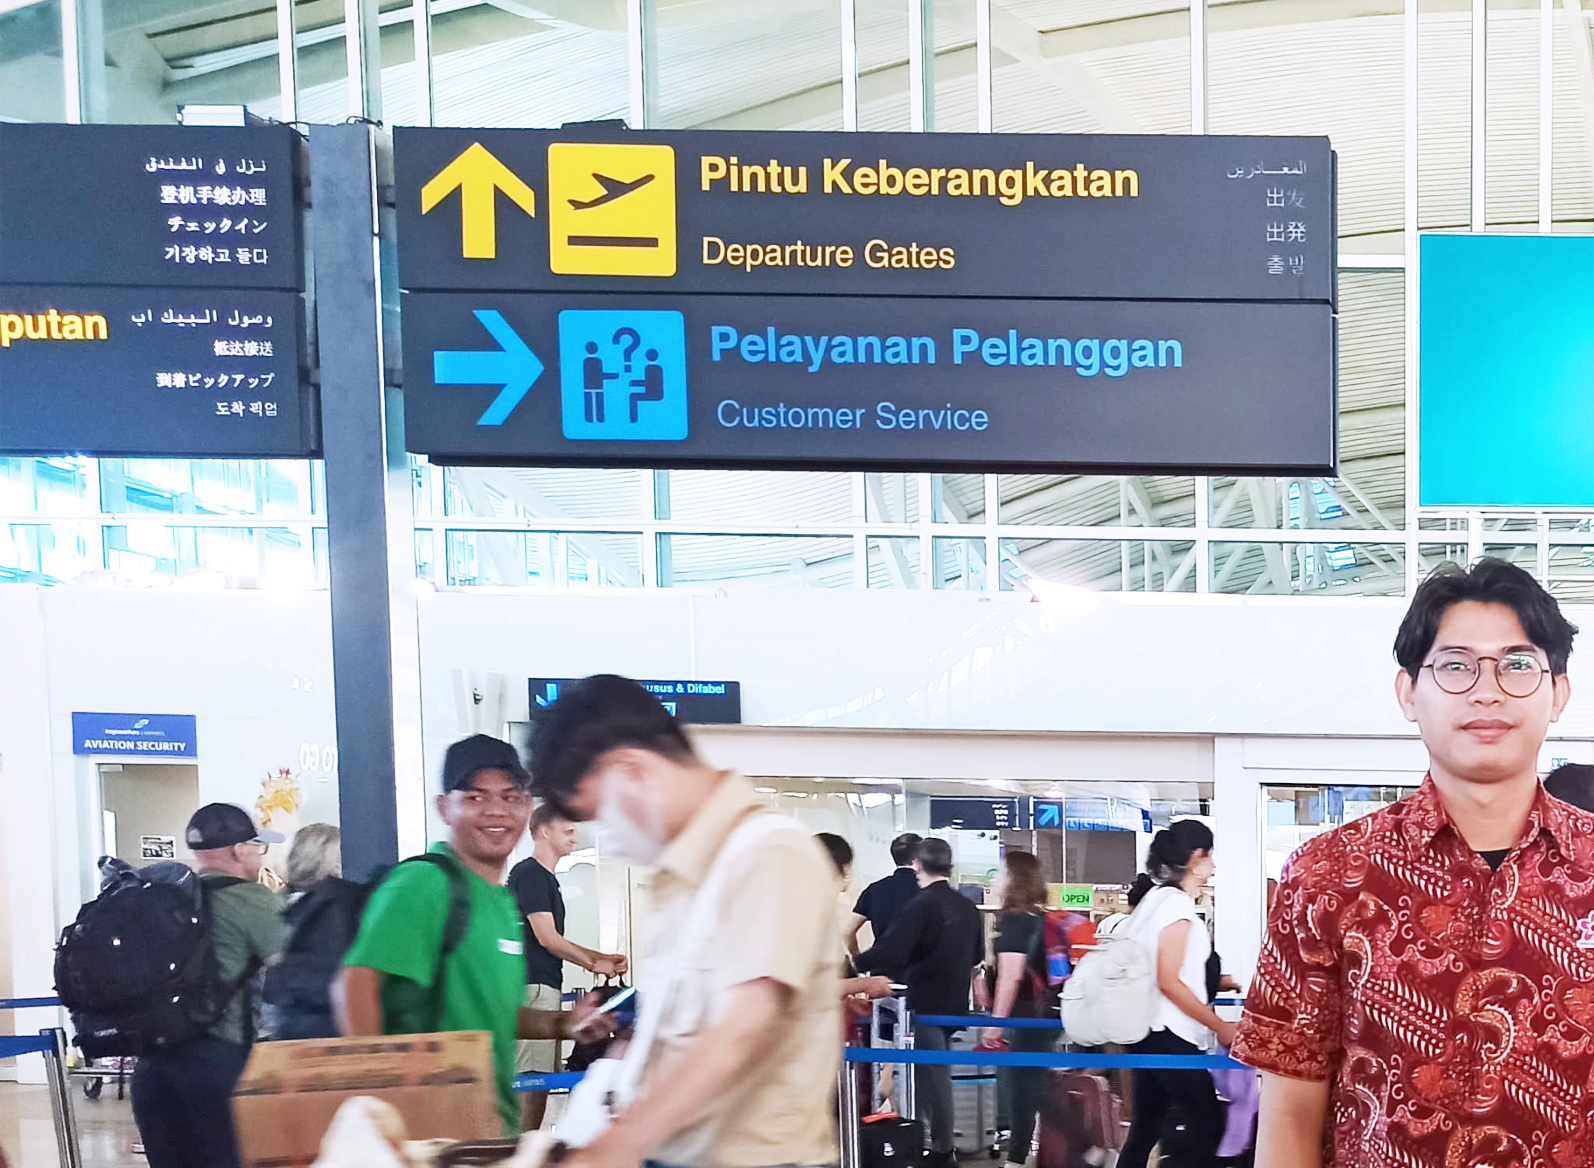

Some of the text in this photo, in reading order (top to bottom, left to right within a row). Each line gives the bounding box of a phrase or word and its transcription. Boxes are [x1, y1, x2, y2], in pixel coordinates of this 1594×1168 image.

[700, 156, 1140, 206] Pintu Keberangkatan
[160, 185, 267, 206] 登机手续办理
[168, 216, 268, 234] チェックイン
[1266, 221, 1307, 242] 出発
[165, 244, 268, 265] 기장하고 들다
[702, 236, 955, 271] Departure Gates
[0, 308, 108, 347] putan
[213, 339, 274, 356] 抵达接送
[711, 325, 1184, 377] Pelayanan Pelanggan
[717, 400, 989, 431] Customer Service
[642, 683, 726, 694] usus & Difabel
[84, 739, 186, 752] AVIATION SECURITY
[1062, 894, 1090, 904] OPEN
